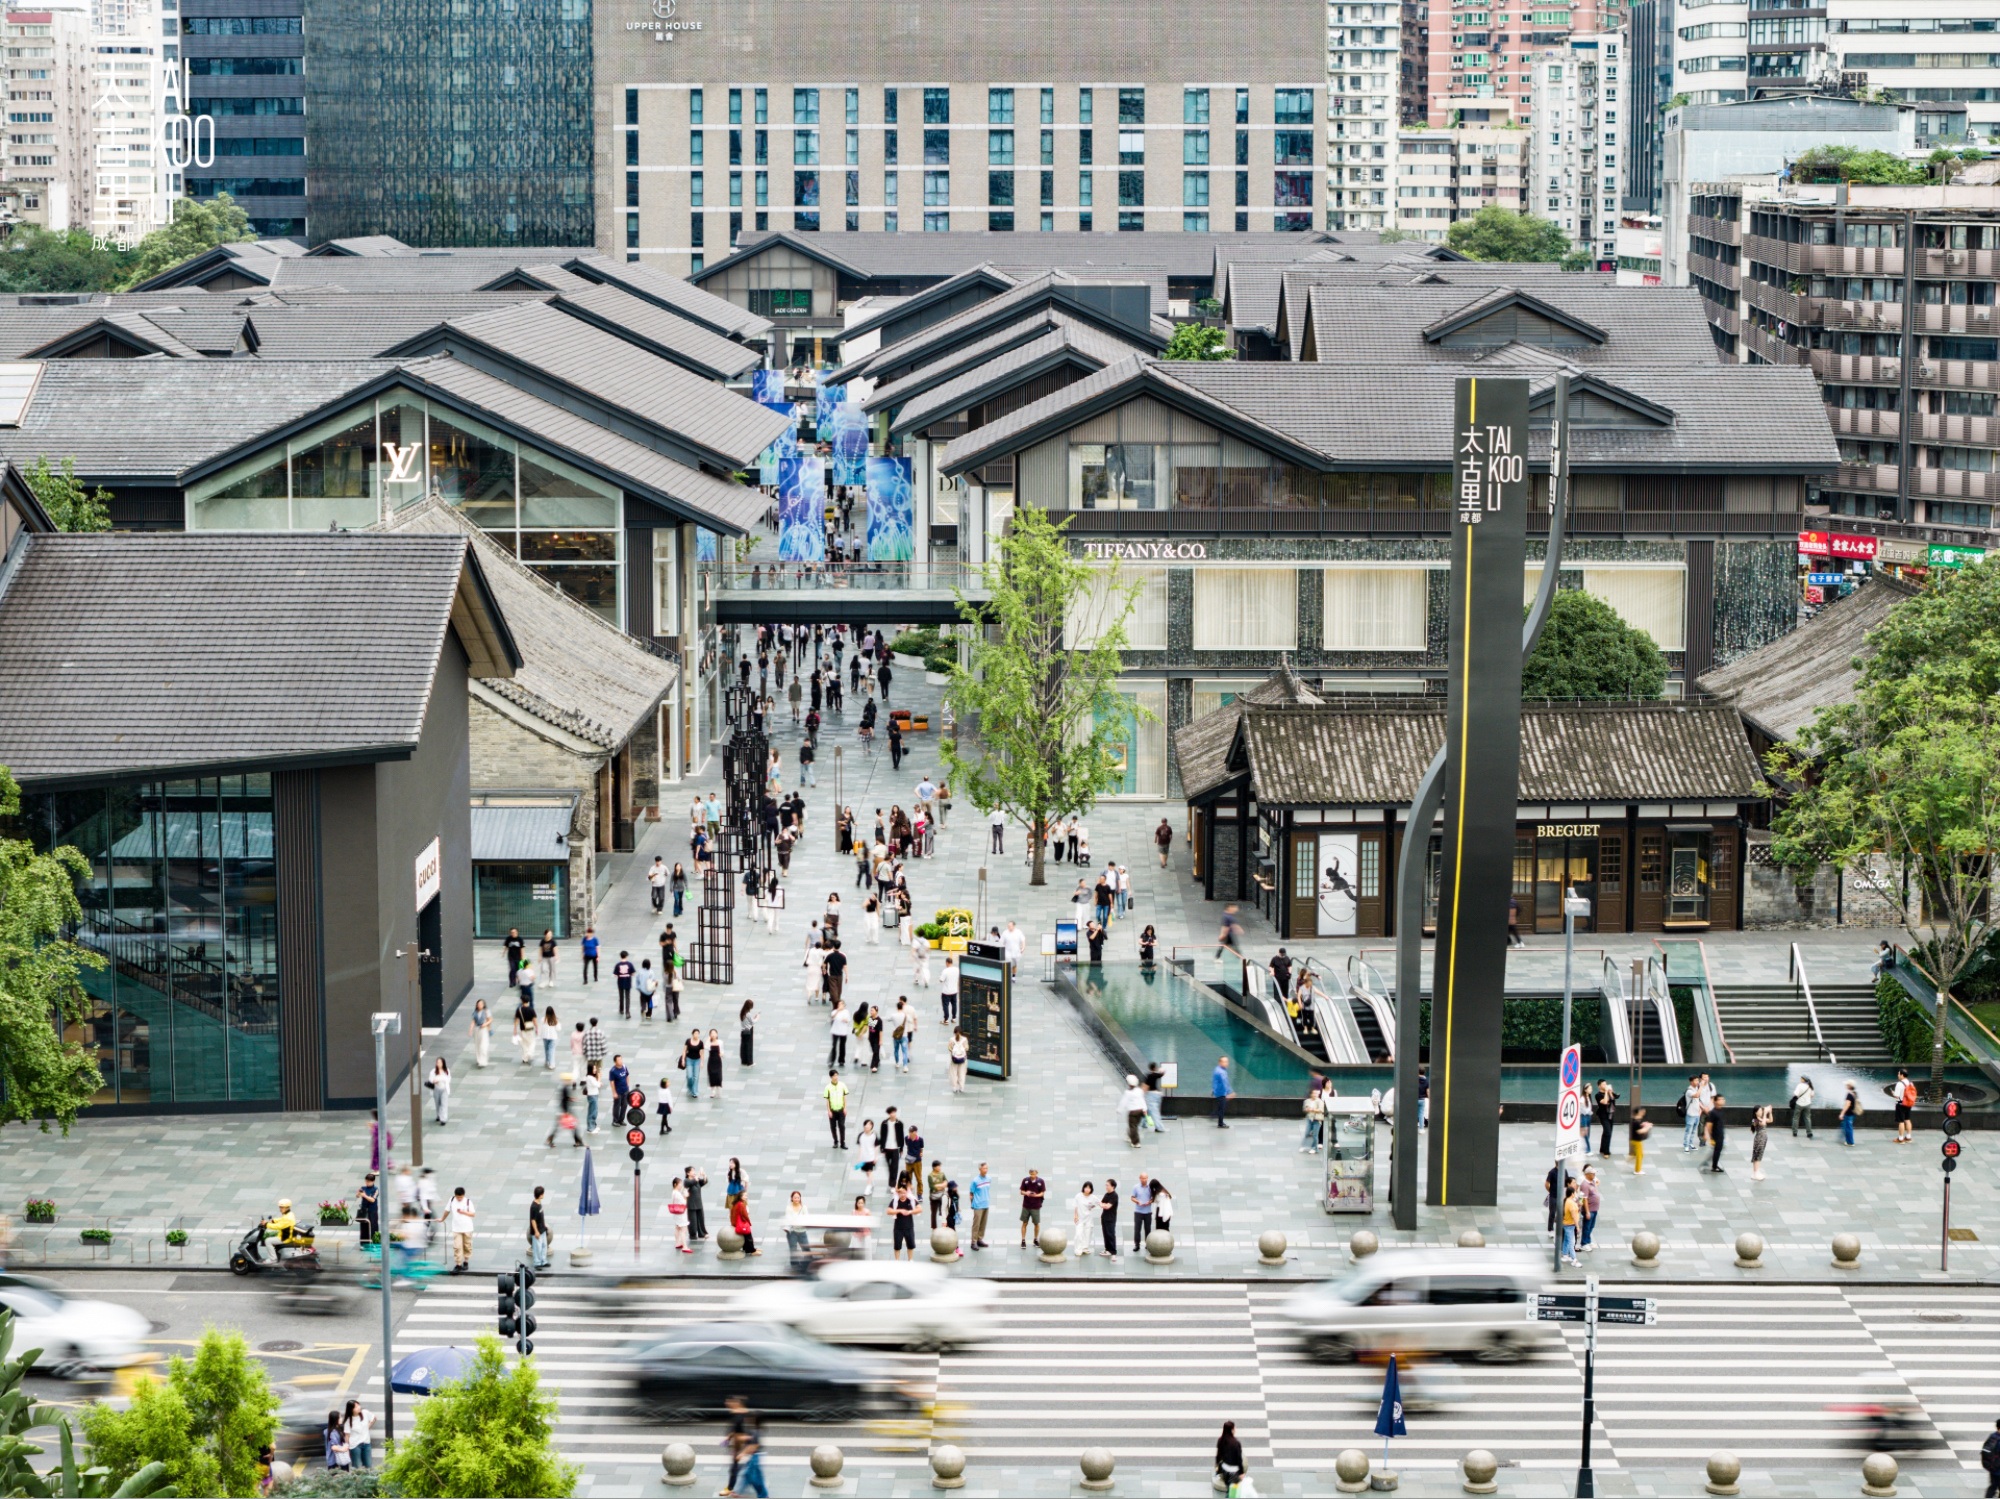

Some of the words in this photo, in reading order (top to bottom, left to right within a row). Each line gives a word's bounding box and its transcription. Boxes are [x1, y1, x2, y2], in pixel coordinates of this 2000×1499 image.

[626, 21, 661, 30] UPPER
[665, 21, 703, 30] HOUSE
[1485, 425, 1511, 454] TAI
[1458, 425, 1484, 512] 太古里
[1488, 454, 1523, 483] KOO
[1487, 482, 1502, 511] LI
[1459, 511, 1482, 524] 成都
[1536, 824, 1601, 838] BREGUET
[418, 857, 437, 889] GUCCI
[1563, 1100, 1575, 1121] 40
